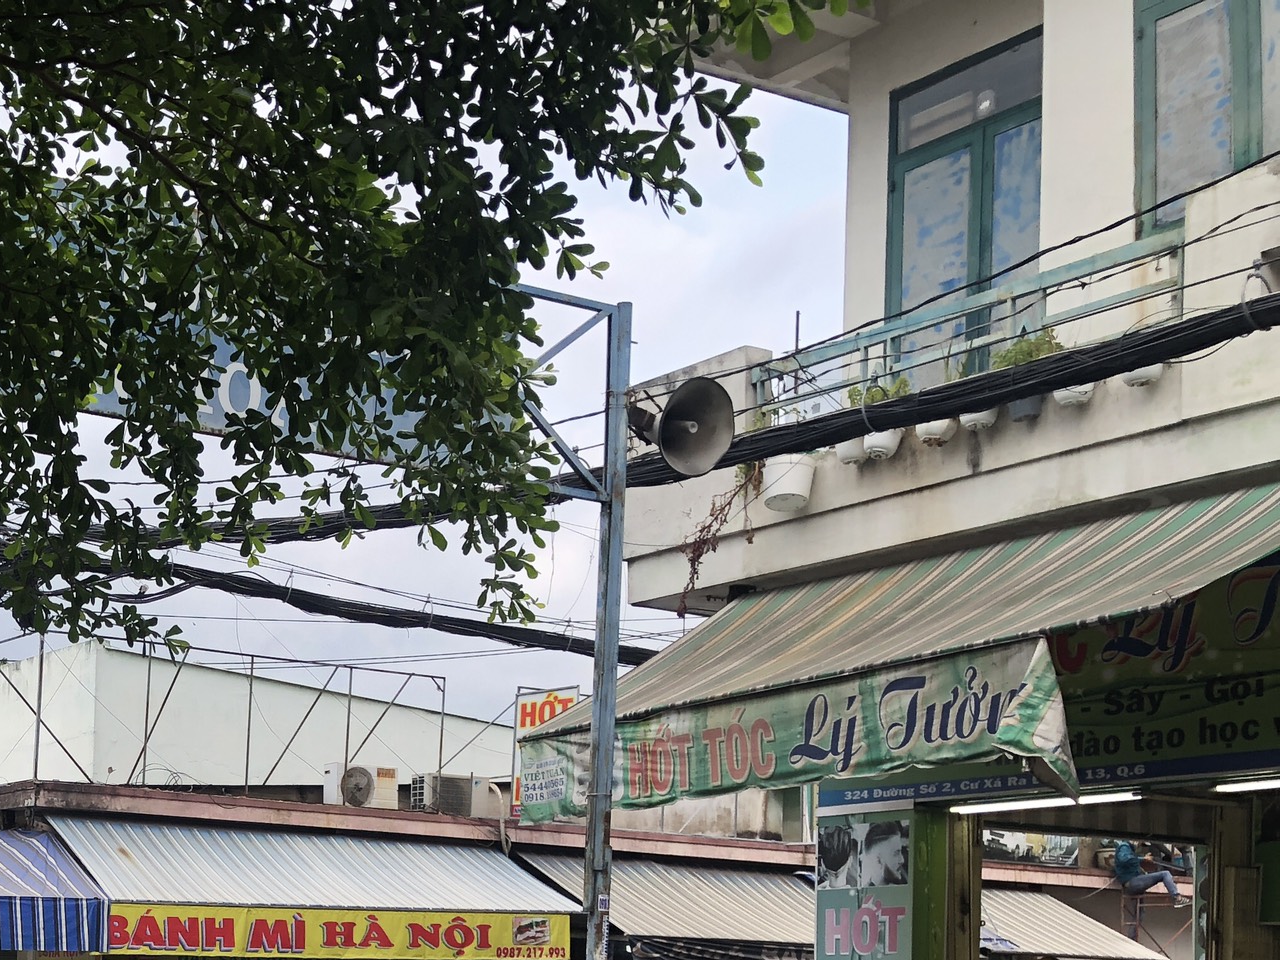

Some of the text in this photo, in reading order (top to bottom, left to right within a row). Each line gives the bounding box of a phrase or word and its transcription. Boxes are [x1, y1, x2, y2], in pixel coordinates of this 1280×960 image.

[627, 665, 1027, 799] HỚT TÓC Lý Tưởn
[1132, 726, 1184, 756] tạo
[1199, 717, 1259, 748] học
[844, 789, 869, 800] 324
[873, 786, 915, 799] Đường
[919, 782, 939, 794] Số
[960, 780, 980, 791] Cư
[984, 778, 1002, 788] Xá
[1117, 765, 1145, 776] Q.6
[108, 909, 492, 959] BÁNH MÌ HÀ NỘI
[825, 894, 906, 956] HỚT
[496, 946, 566, 959] 0987.217.993
